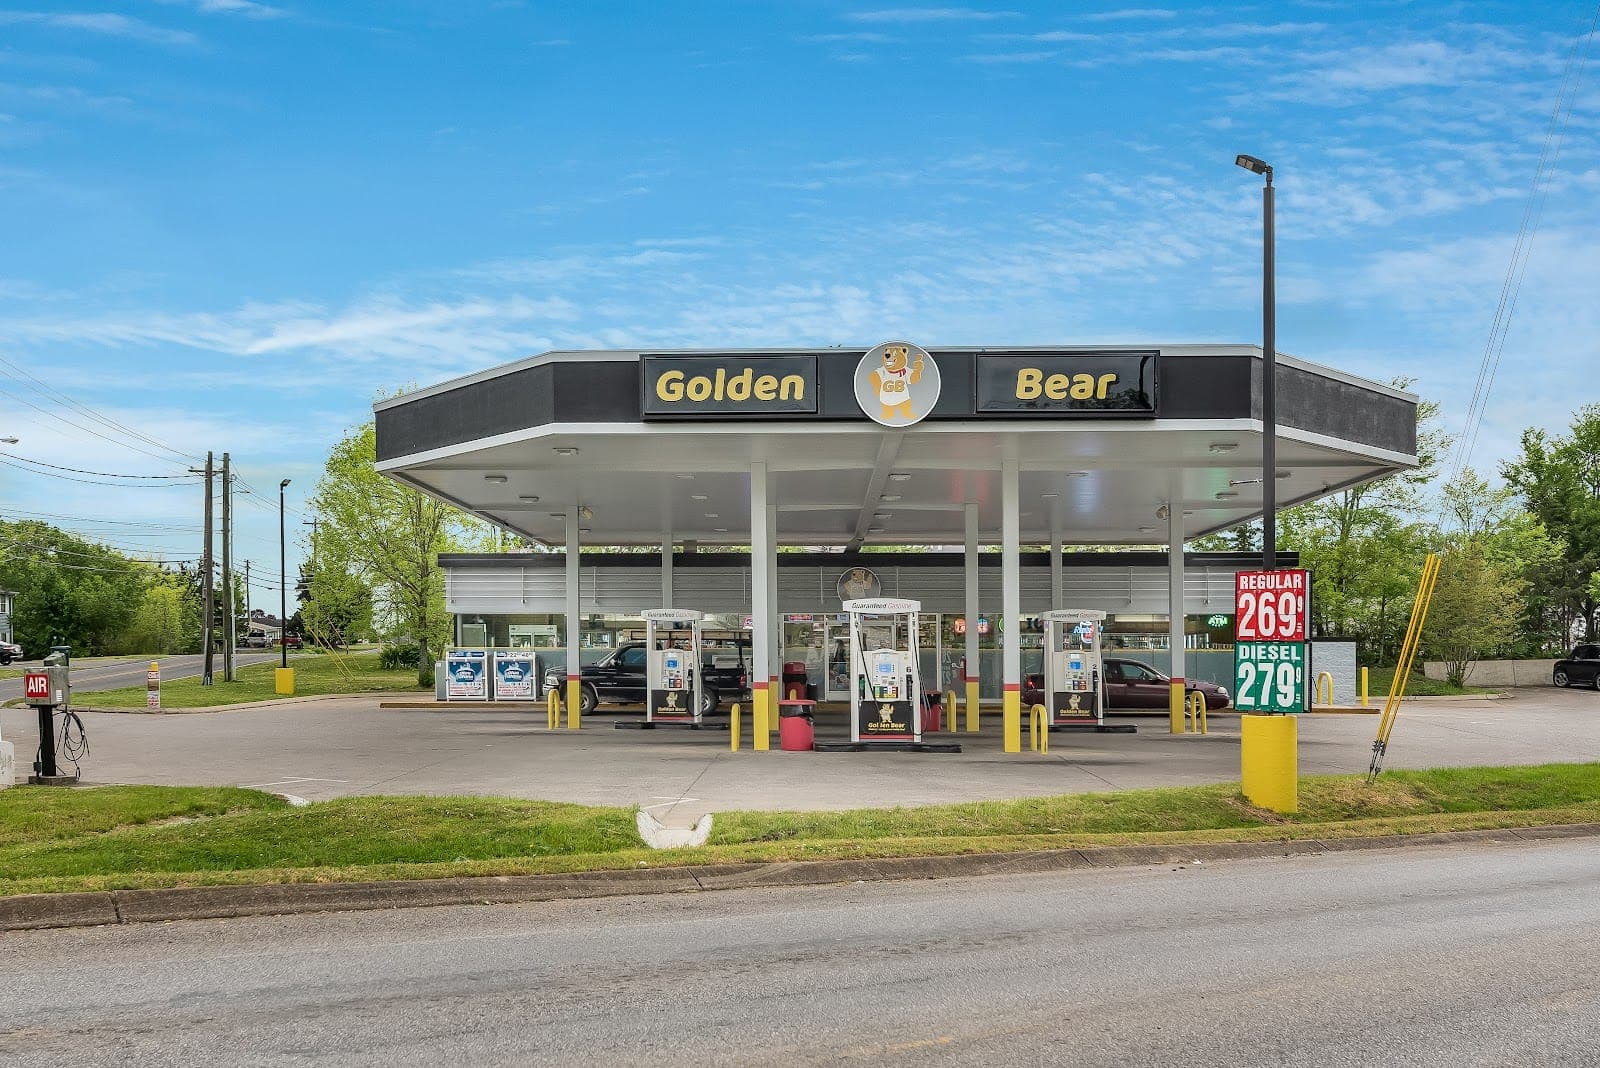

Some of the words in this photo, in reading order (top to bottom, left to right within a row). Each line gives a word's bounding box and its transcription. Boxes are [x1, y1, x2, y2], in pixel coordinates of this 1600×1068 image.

[656, 367, 805, 402] Golden
[1015, 367, 1117, 400] Bear
[882, 380, 905, 393] GB
[1240, 573, 1302, 590] REGULAR
[1207, 616, 1228, 625] ATM
[1239, 645, 1301, 661] DIESEL
[27, 676, 48, 693] AIR
